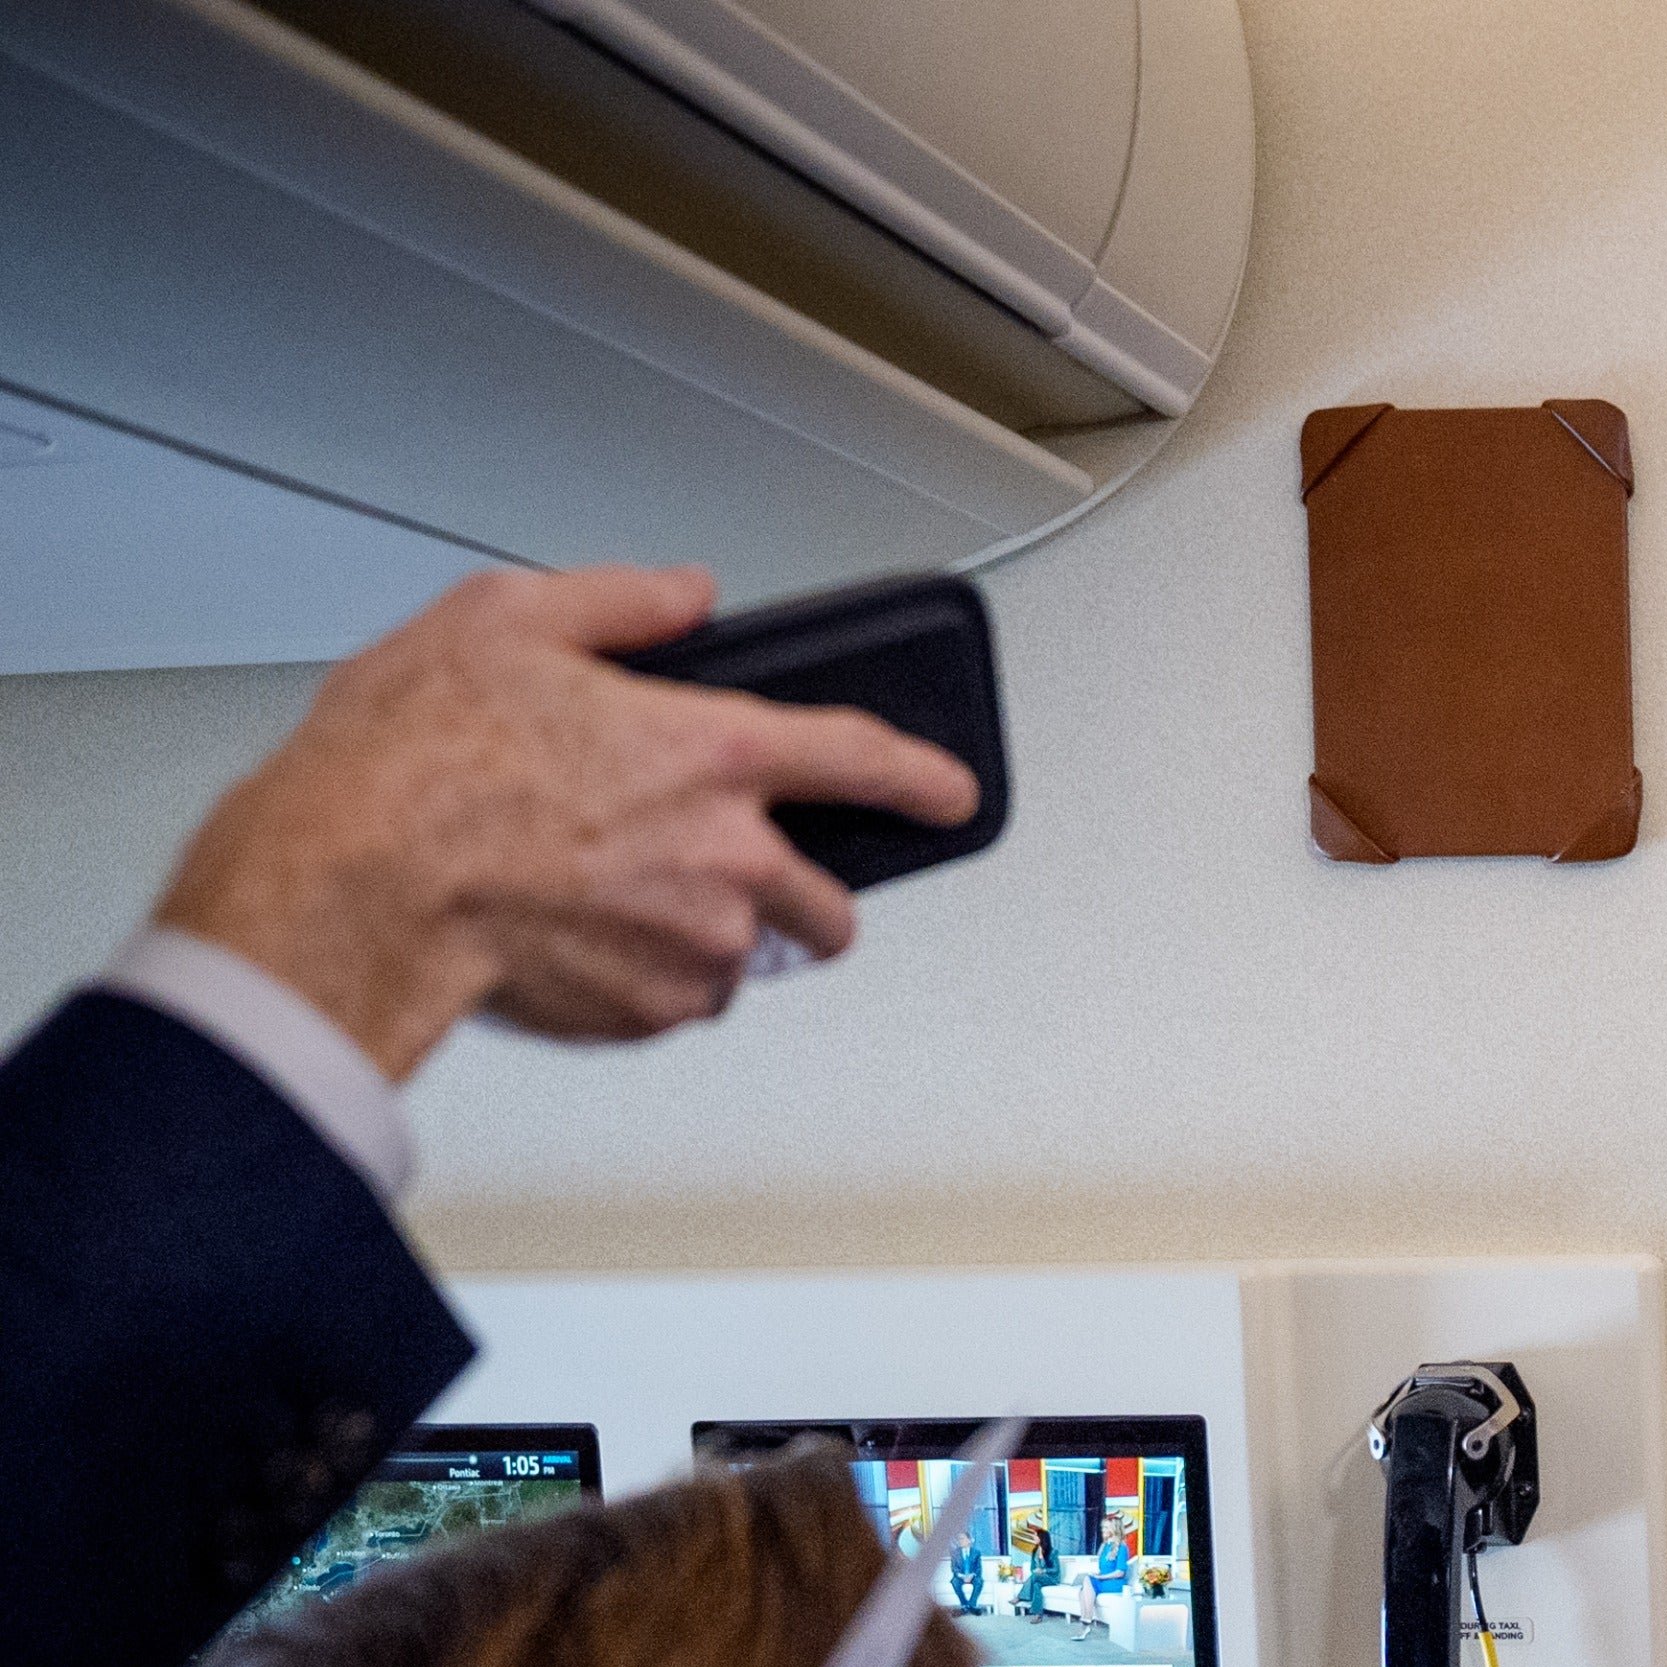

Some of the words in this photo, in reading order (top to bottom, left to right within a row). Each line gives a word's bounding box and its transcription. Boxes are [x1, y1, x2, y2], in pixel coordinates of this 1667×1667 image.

[502, 1455, 540, 1476] 1:05
[543, 1466, 556, 1475] PM
[449, 1467, 481, 1478] Pontiac
[1460, 1622, 1496, 1630] DURG
